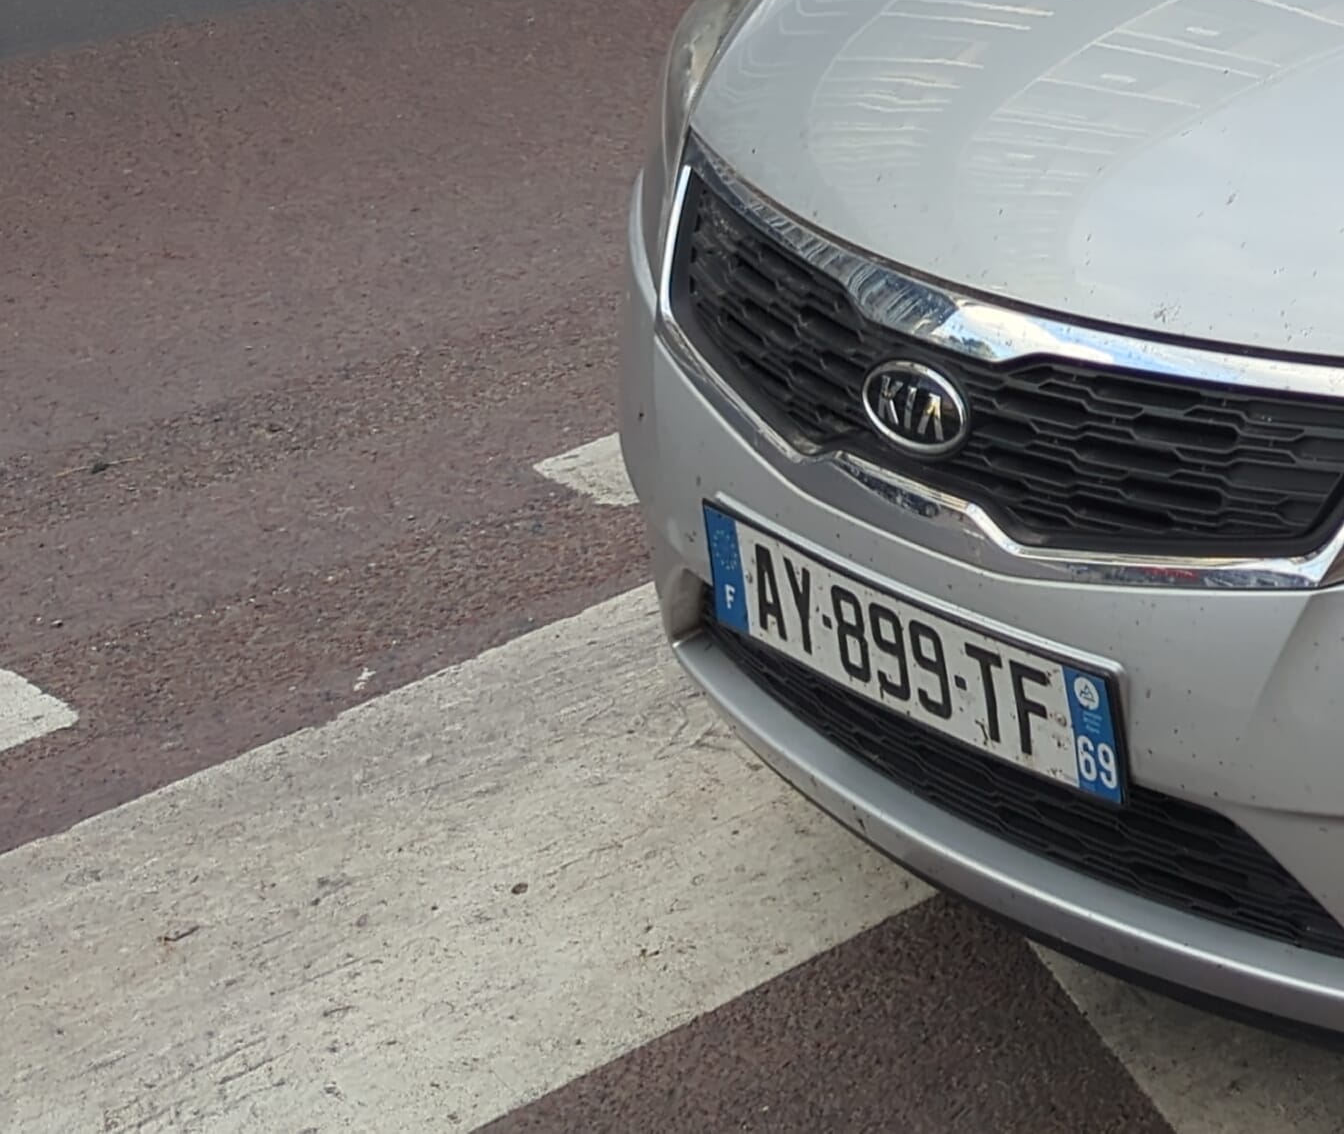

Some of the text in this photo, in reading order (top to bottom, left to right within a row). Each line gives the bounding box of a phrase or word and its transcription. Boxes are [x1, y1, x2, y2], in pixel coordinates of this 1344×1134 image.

[877, 374, 945, 442] KIA
[723, 583, 737, 610] F
[754, 542, 1053, 757] AY-899-TF
[1076, 734, 1119, 790] 69
